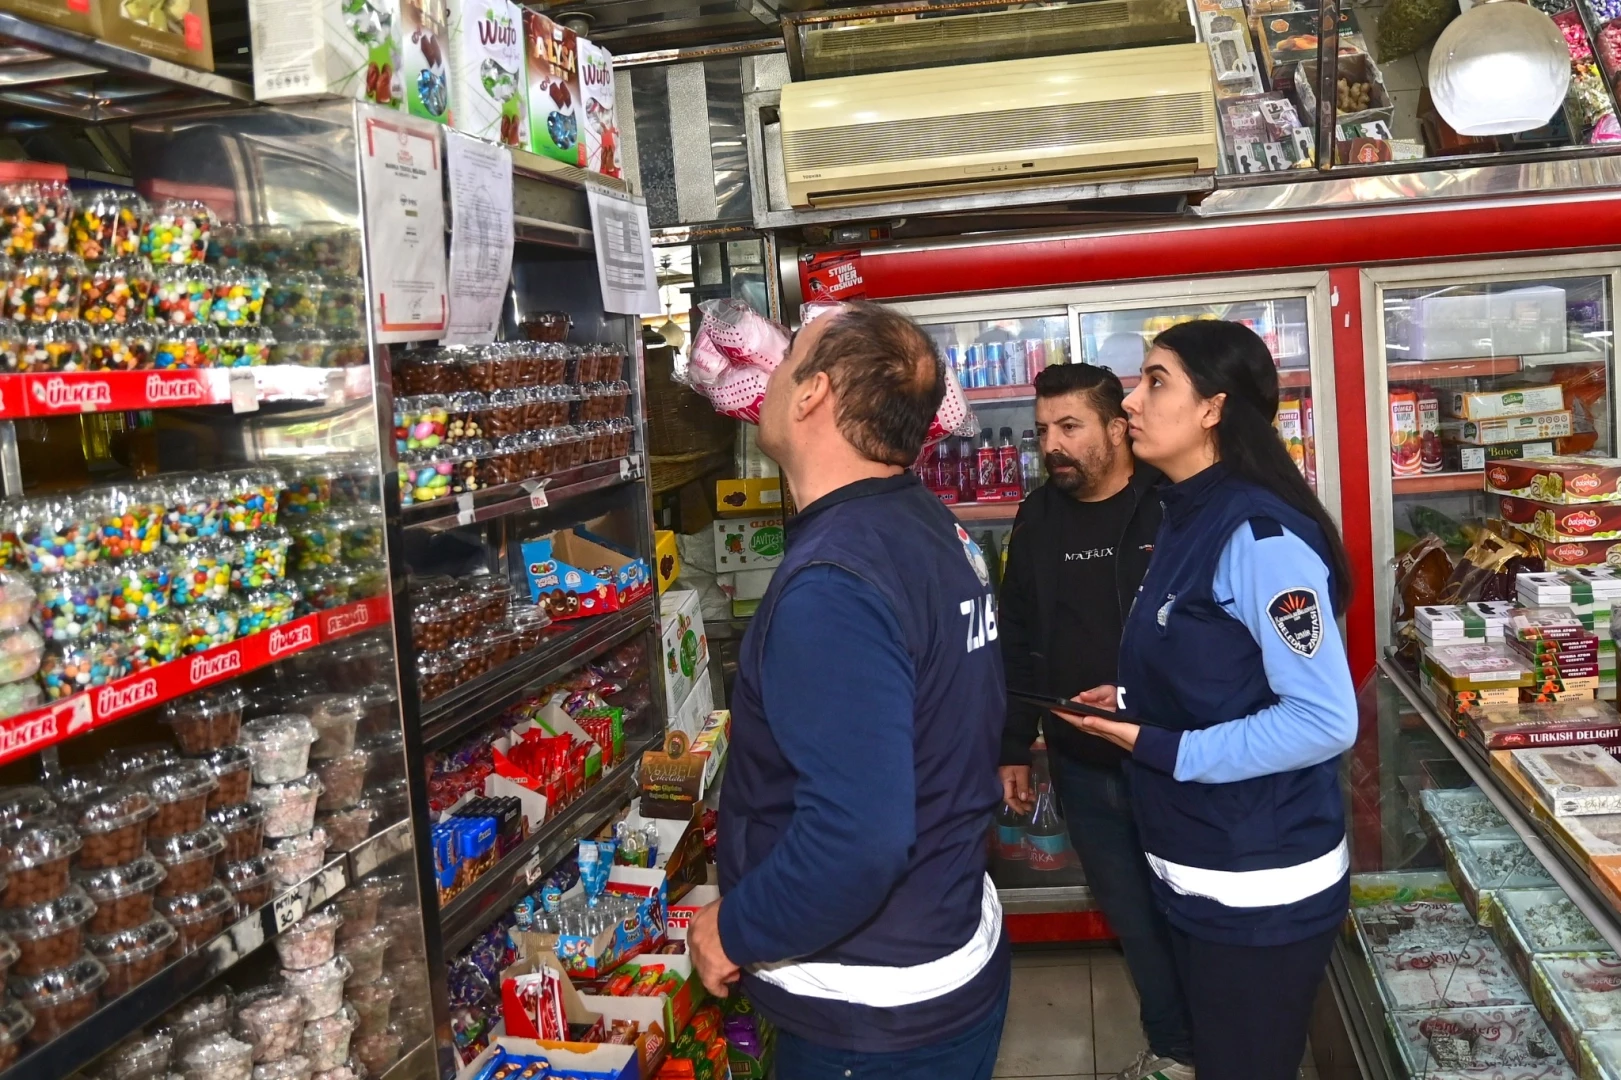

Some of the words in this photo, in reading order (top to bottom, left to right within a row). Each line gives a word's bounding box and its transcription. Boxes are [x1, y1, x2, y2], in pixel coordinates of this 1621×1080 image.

[478, 19, 517, 47] Wufo
[582, 62, 611, 86] Wufo
[838, 269, 857, 283] VER
[46, 377, 111, 408] ÜLKER
[146, 373, 200, 402] ÜLKER
[1488, 446, 1518, 458] Bahçe
[1065, 546, 1115, 562] MATRIX
[960, 593, 998, 653] ZAB
[191, 650, 241, 684] ÜLKER
[97, 678, 158, 718] ÜLKER
[0, 714, 58, 755] LKER
[1529, 731, 1574, 743] TURKISH
[1576, 728, 1619, 741] DELIGHT
[666, 911, 692, 919] LKER
